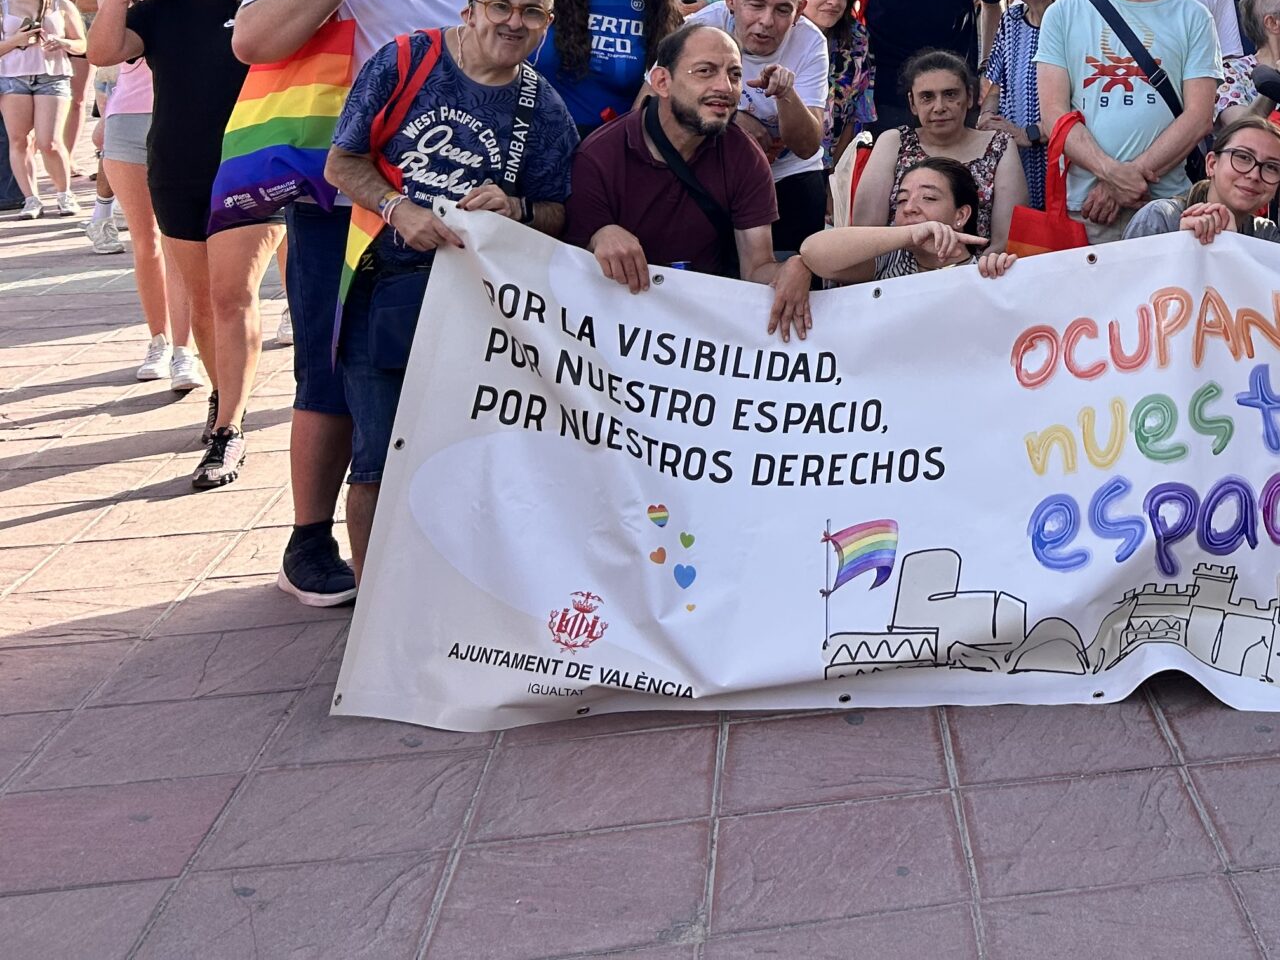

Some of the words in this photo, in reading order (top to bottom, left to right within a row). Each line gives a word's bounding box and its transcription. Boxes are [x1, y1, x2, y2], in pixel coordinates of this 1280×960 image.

[588, 13, 644, 36] ERTO
[591, 34, 631, 53] ICO
[402, 110, 437, 139] WEST
[440, 106, 483, 133] PACIFIC
[478, 128, 502, 170] COAST
[417, 124, 484, 168] Ocean
[504, 117, 530, 183] BIMBAY
[518, 62, 539, 108] BIMB
[397, 151, 493, 196] Beachsi
[482, 278, 547, 324] POR
[560, 306, 597, 349] LA
[618, 323, 842, 386] VISIBILIDAD,
[484, 327, 543, 378] POR
[555, 348, 716, 427] NUESTRO
[732, 398, 888, 434] ESPACIO,
[470, 384, 548, 432] POR
[559, 404, 733, 484] NUESTROS
[751, 446, 946, 487] DERECHOS
[448, 642, 564, 676] AJUNTAMENT
[565, 661, 594, 681] DE
[599, 666, 694, 699] VALÈNCIA
[527, 682, 584, 697] IGUALTAT
